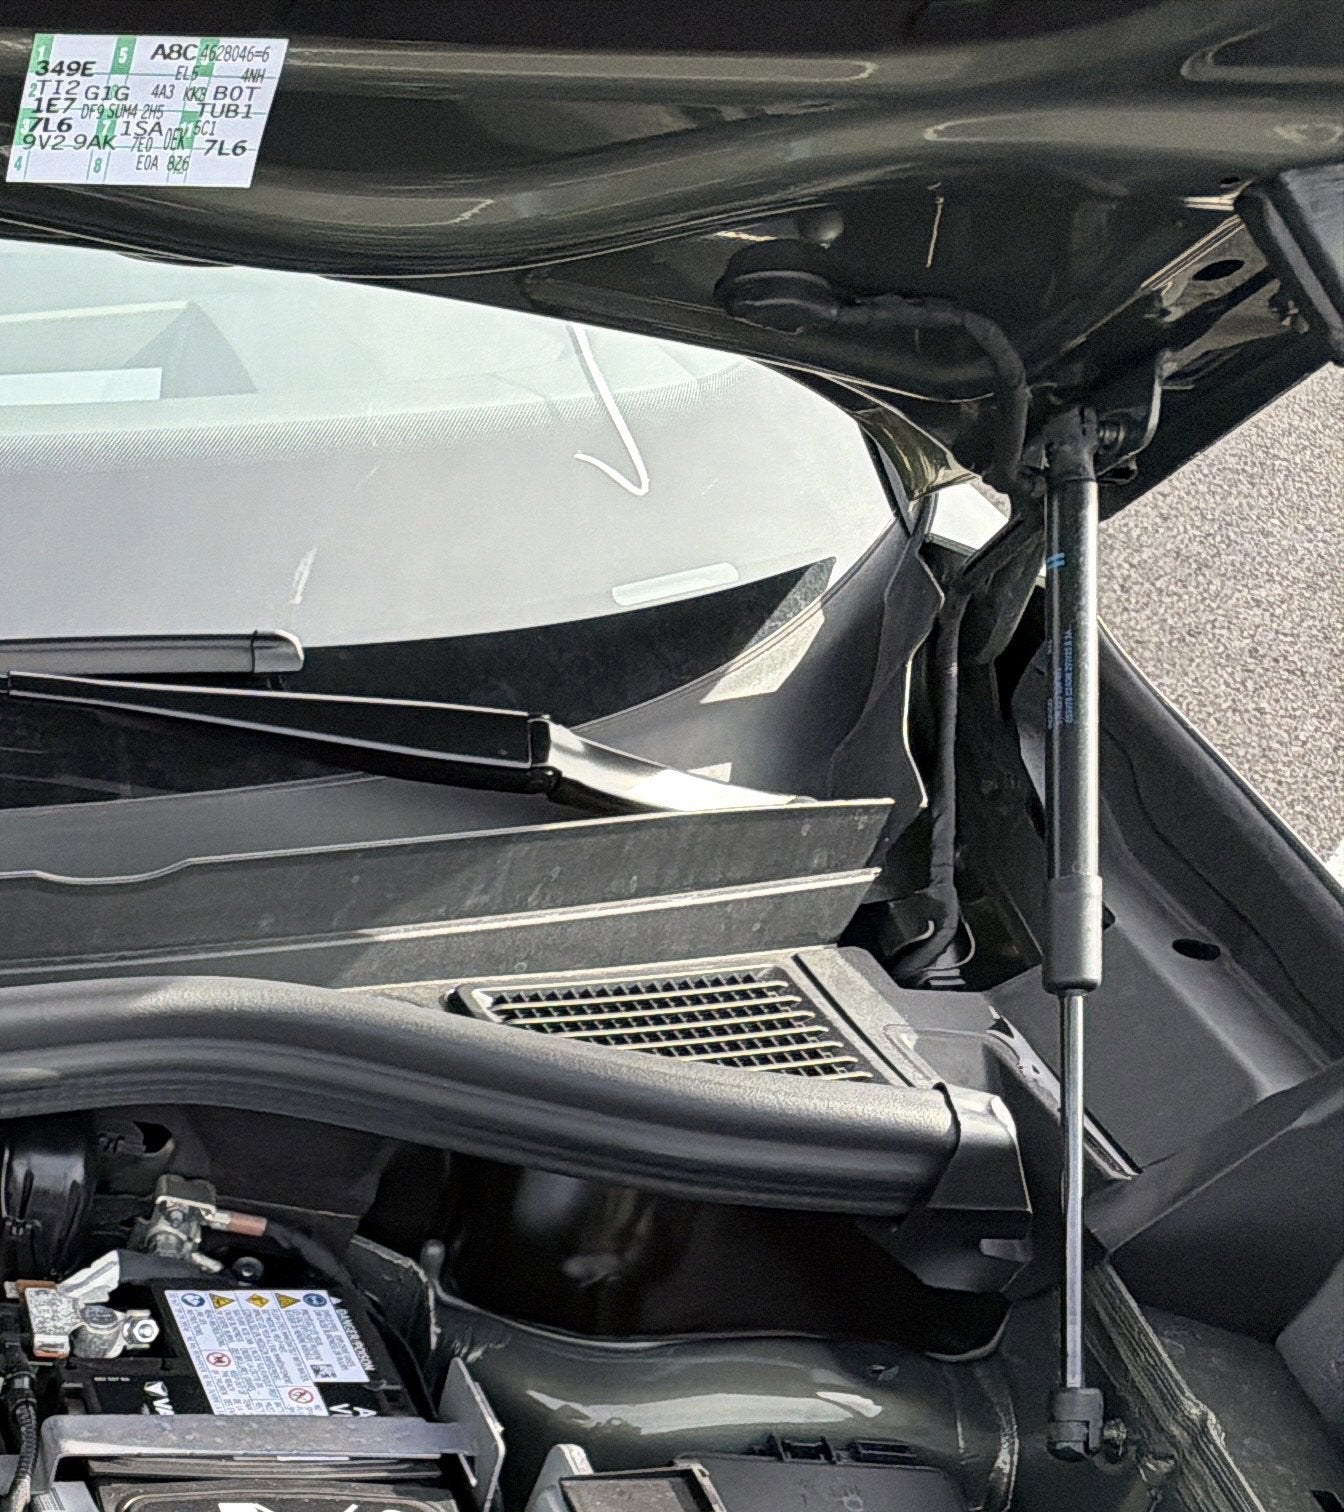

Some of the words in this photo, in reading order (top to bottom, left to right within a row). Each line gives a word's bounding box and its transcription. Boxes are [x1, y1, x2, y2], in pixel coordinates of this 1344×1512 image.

[119, 48, 128, 63] 5
[150, 43, 199, 60] A8C
[34, 60, 96, 76] 349E
[150, 84, 175, 99] 4A3
[32, 97, 78, 113] 1E7
[28, 117, 73, 133] 7L6
[120, 120, 163, 136] 1SA
[22, 134, 62, 150] 9V2
[74, 134, 117, 150] 9AK
[204, 140, 248, 156] 7L6
[14, 156, 23, 171] 4
[93, 157, 102, 173] 8
